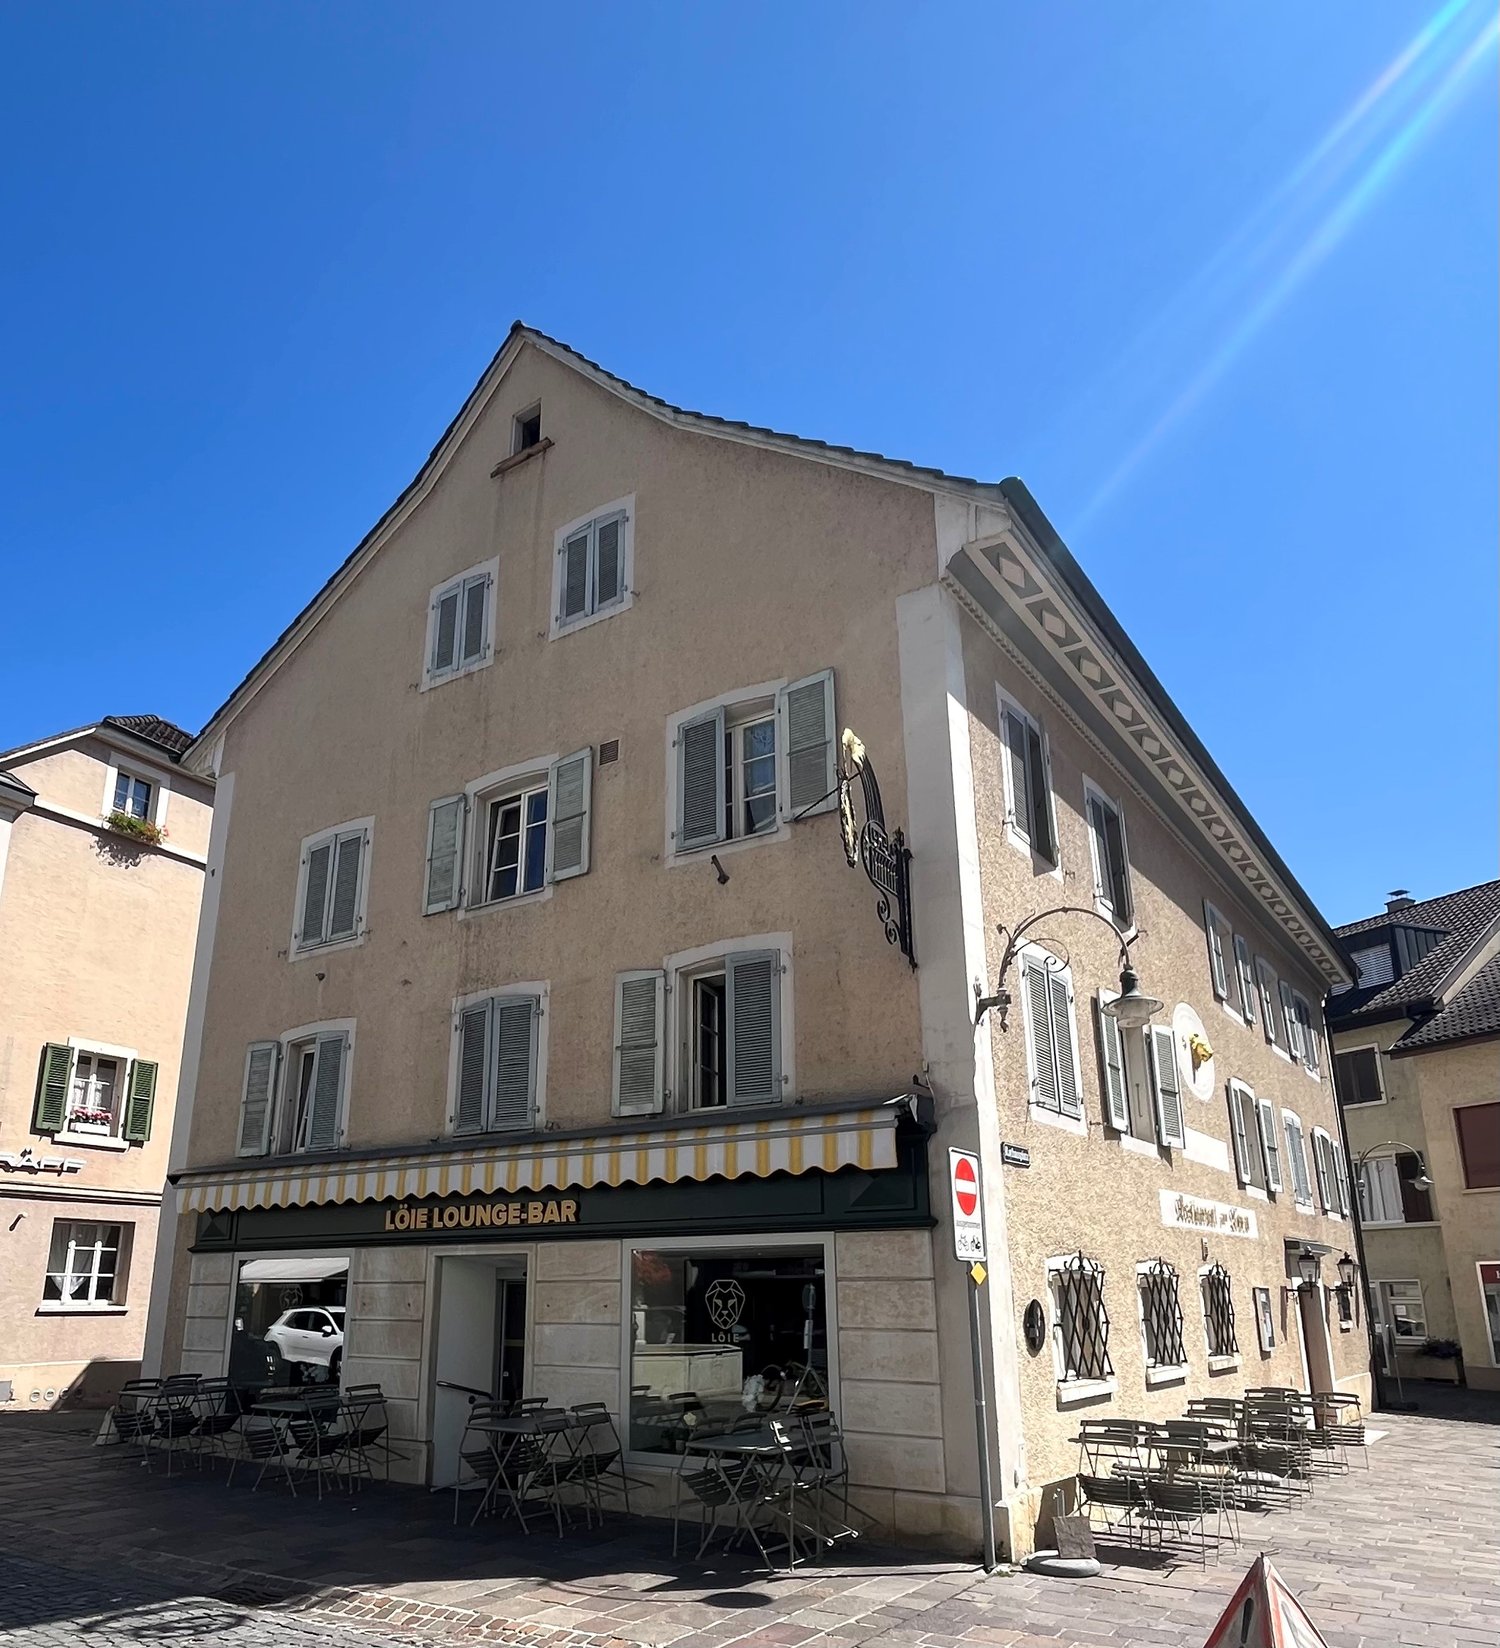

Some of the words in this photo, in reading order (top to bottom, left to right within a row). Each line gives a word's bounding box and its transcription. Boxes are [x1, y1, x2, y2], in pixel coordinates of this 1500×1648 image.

[384, 1203, 428, 1231] LÖIE
[432, 1199, 577, 1229] LOUNGE-BAR
[711, 1331, 740, 1343] LÖIE
